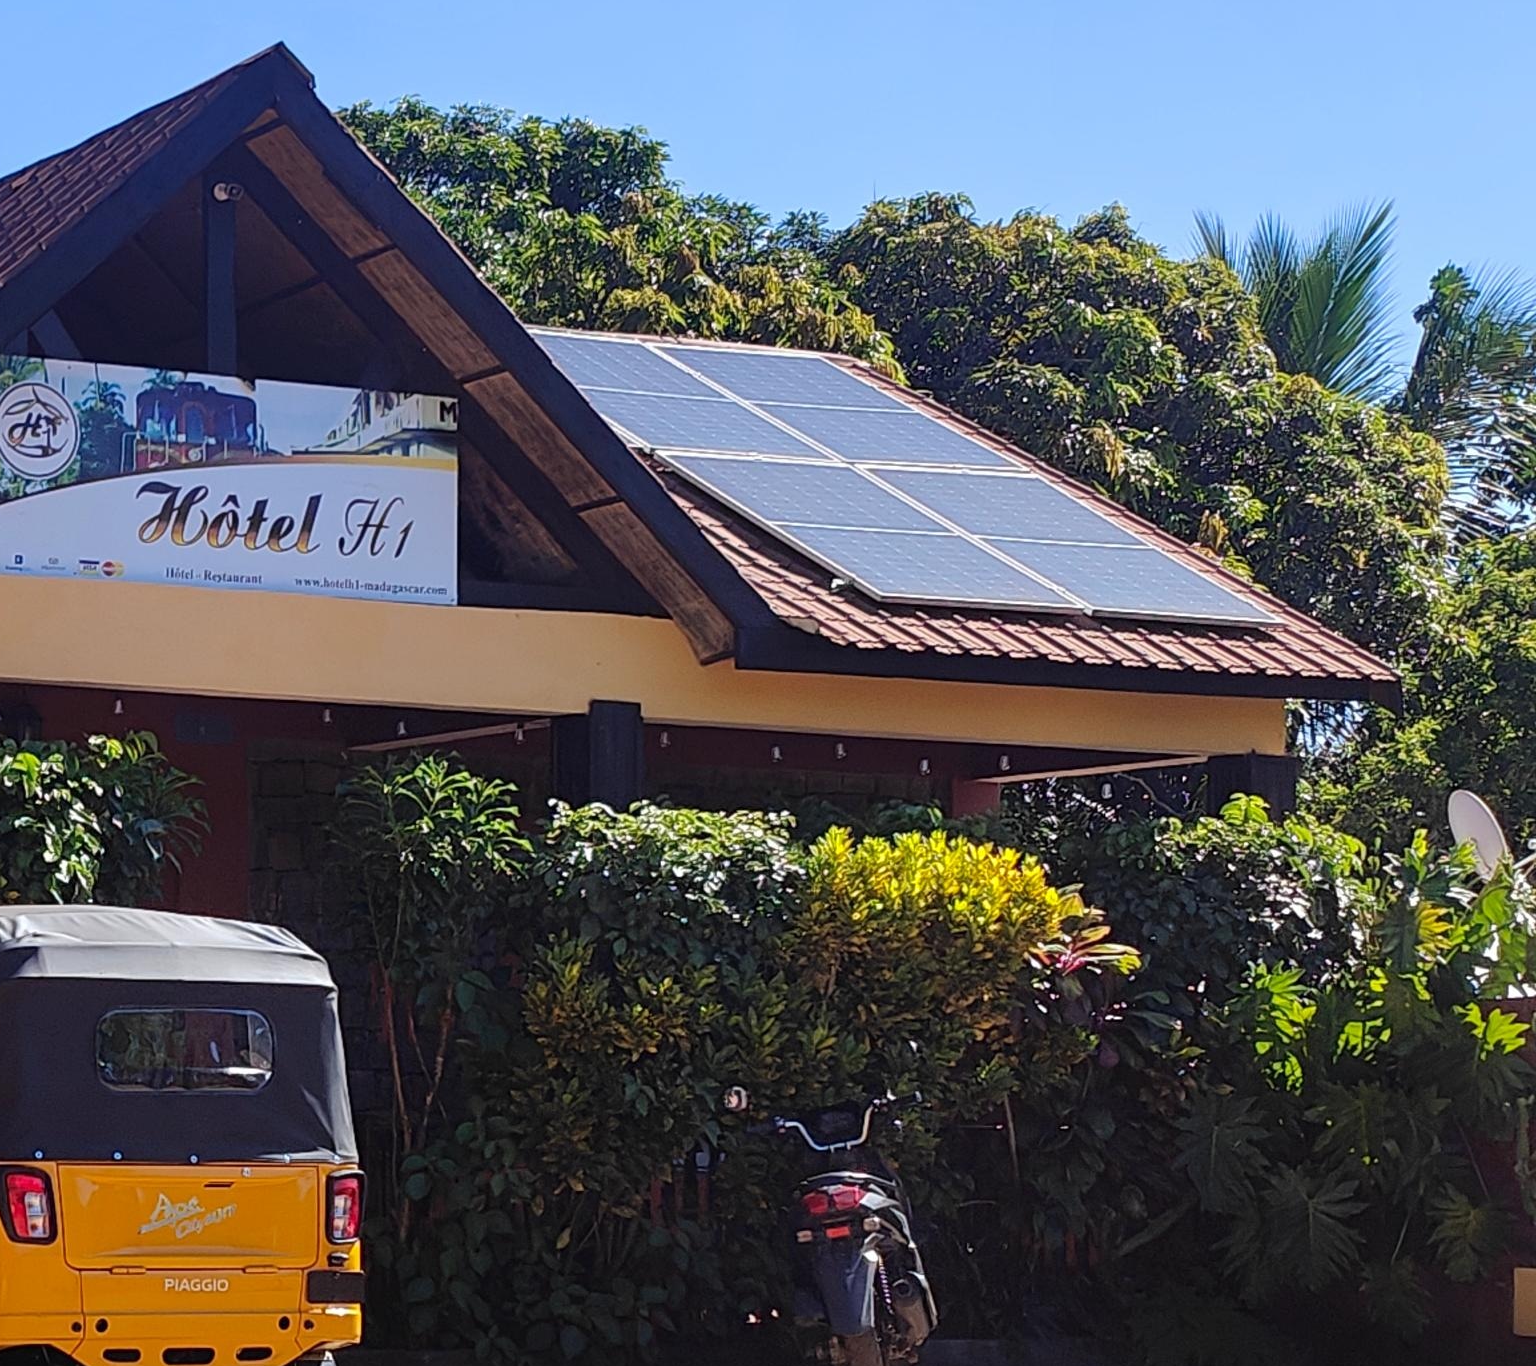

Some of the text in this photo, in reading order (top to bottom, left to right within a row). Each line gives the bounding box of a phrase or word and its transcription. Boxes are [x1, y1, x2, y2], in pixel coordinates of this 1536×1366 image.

[135, 480, 414, 558] Hôtel H1
[165, 566, 194, 580] Hôtel
[203, 569, 263, 585] Restaurant
[164, 1278, 229, 1292] PIAGGIO
